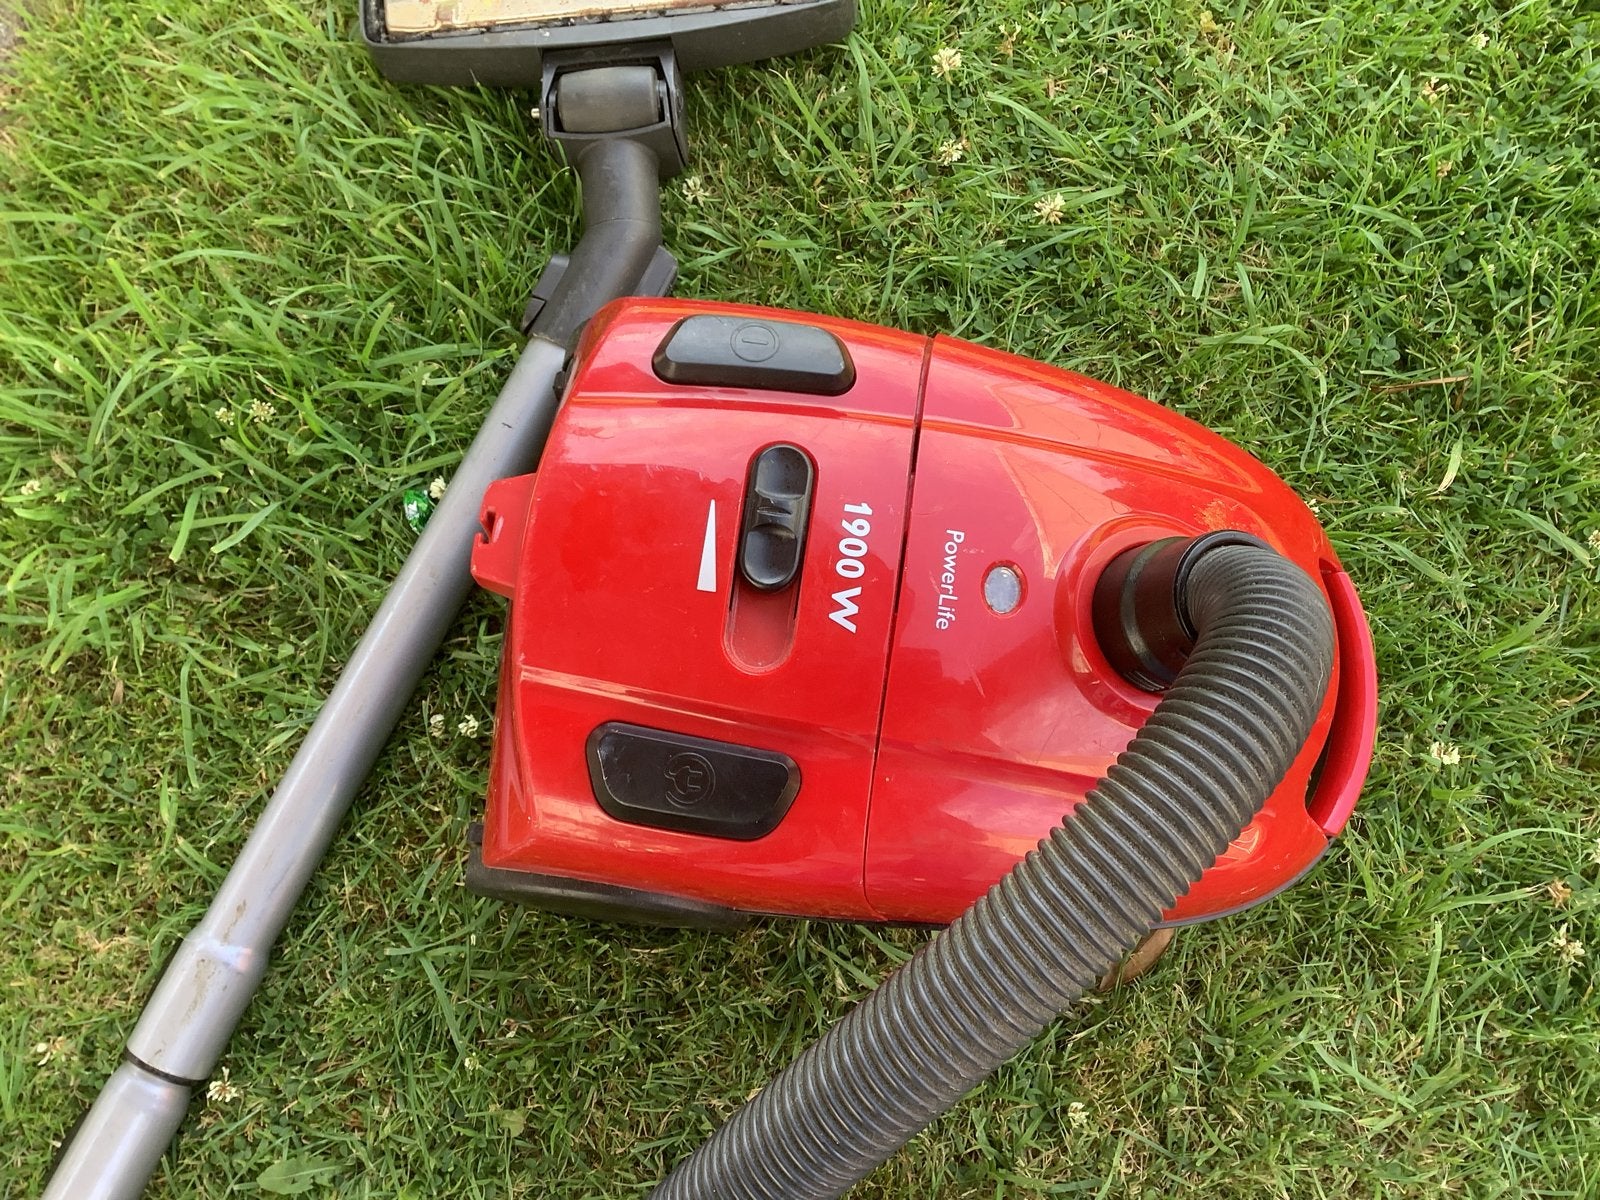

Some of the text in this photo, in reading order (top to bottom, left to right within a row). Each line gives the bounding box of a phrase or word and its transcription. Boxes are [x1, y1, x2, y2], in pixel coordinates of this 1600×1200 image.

[828, 502, 873, 633] 1900 W
[936, 529, 965, 630] PowerLife
